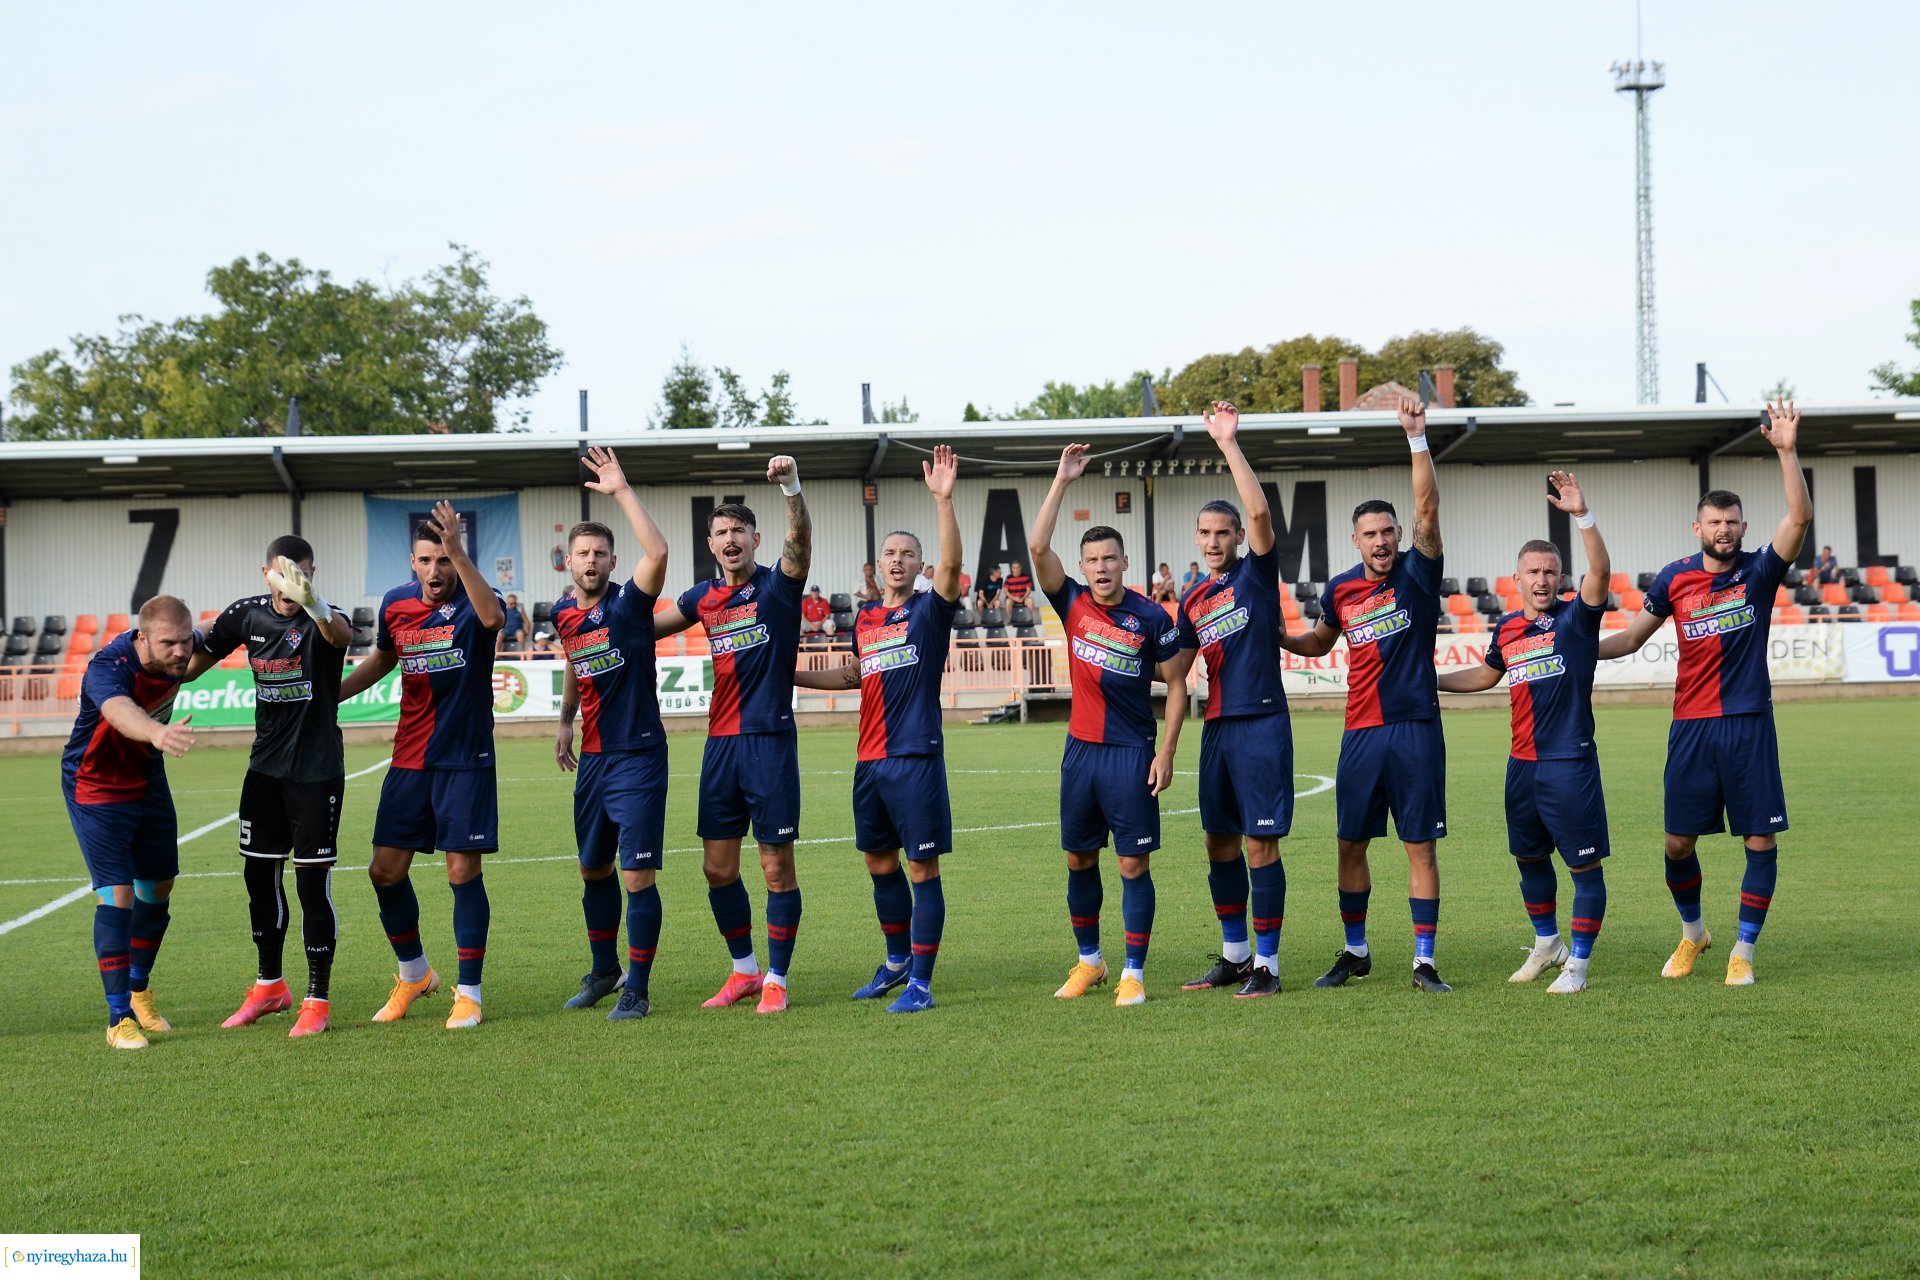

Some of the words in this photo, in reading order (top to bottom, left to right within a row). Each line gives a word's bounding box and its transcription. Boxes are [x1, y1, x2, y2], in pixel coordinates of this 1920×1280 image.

[864, 485, 876, 500] E
[1118, 494, 1128, 508] F
[1853, 466, 1899, 567] L
[1258, 480, 1330, 583] M
[974, 488, 1036, 592] A
[1682, 583, 1747, 613] REVESZ
[1078, 615, 1145, 649] REVESZ
[1771, 639, 1828, 660] DEN
[777, 827, 794, 835] JAKO
[1436, 821, 1445, 829] JA
[919, 841, 935, 851] JAKO
[1137, 836, 1153, 845] JAKO
[316, 847, 332, 855] JAKO
[636, 851, 652, 860] JAKO
[1578, 847, 1595, 857] JAKO
